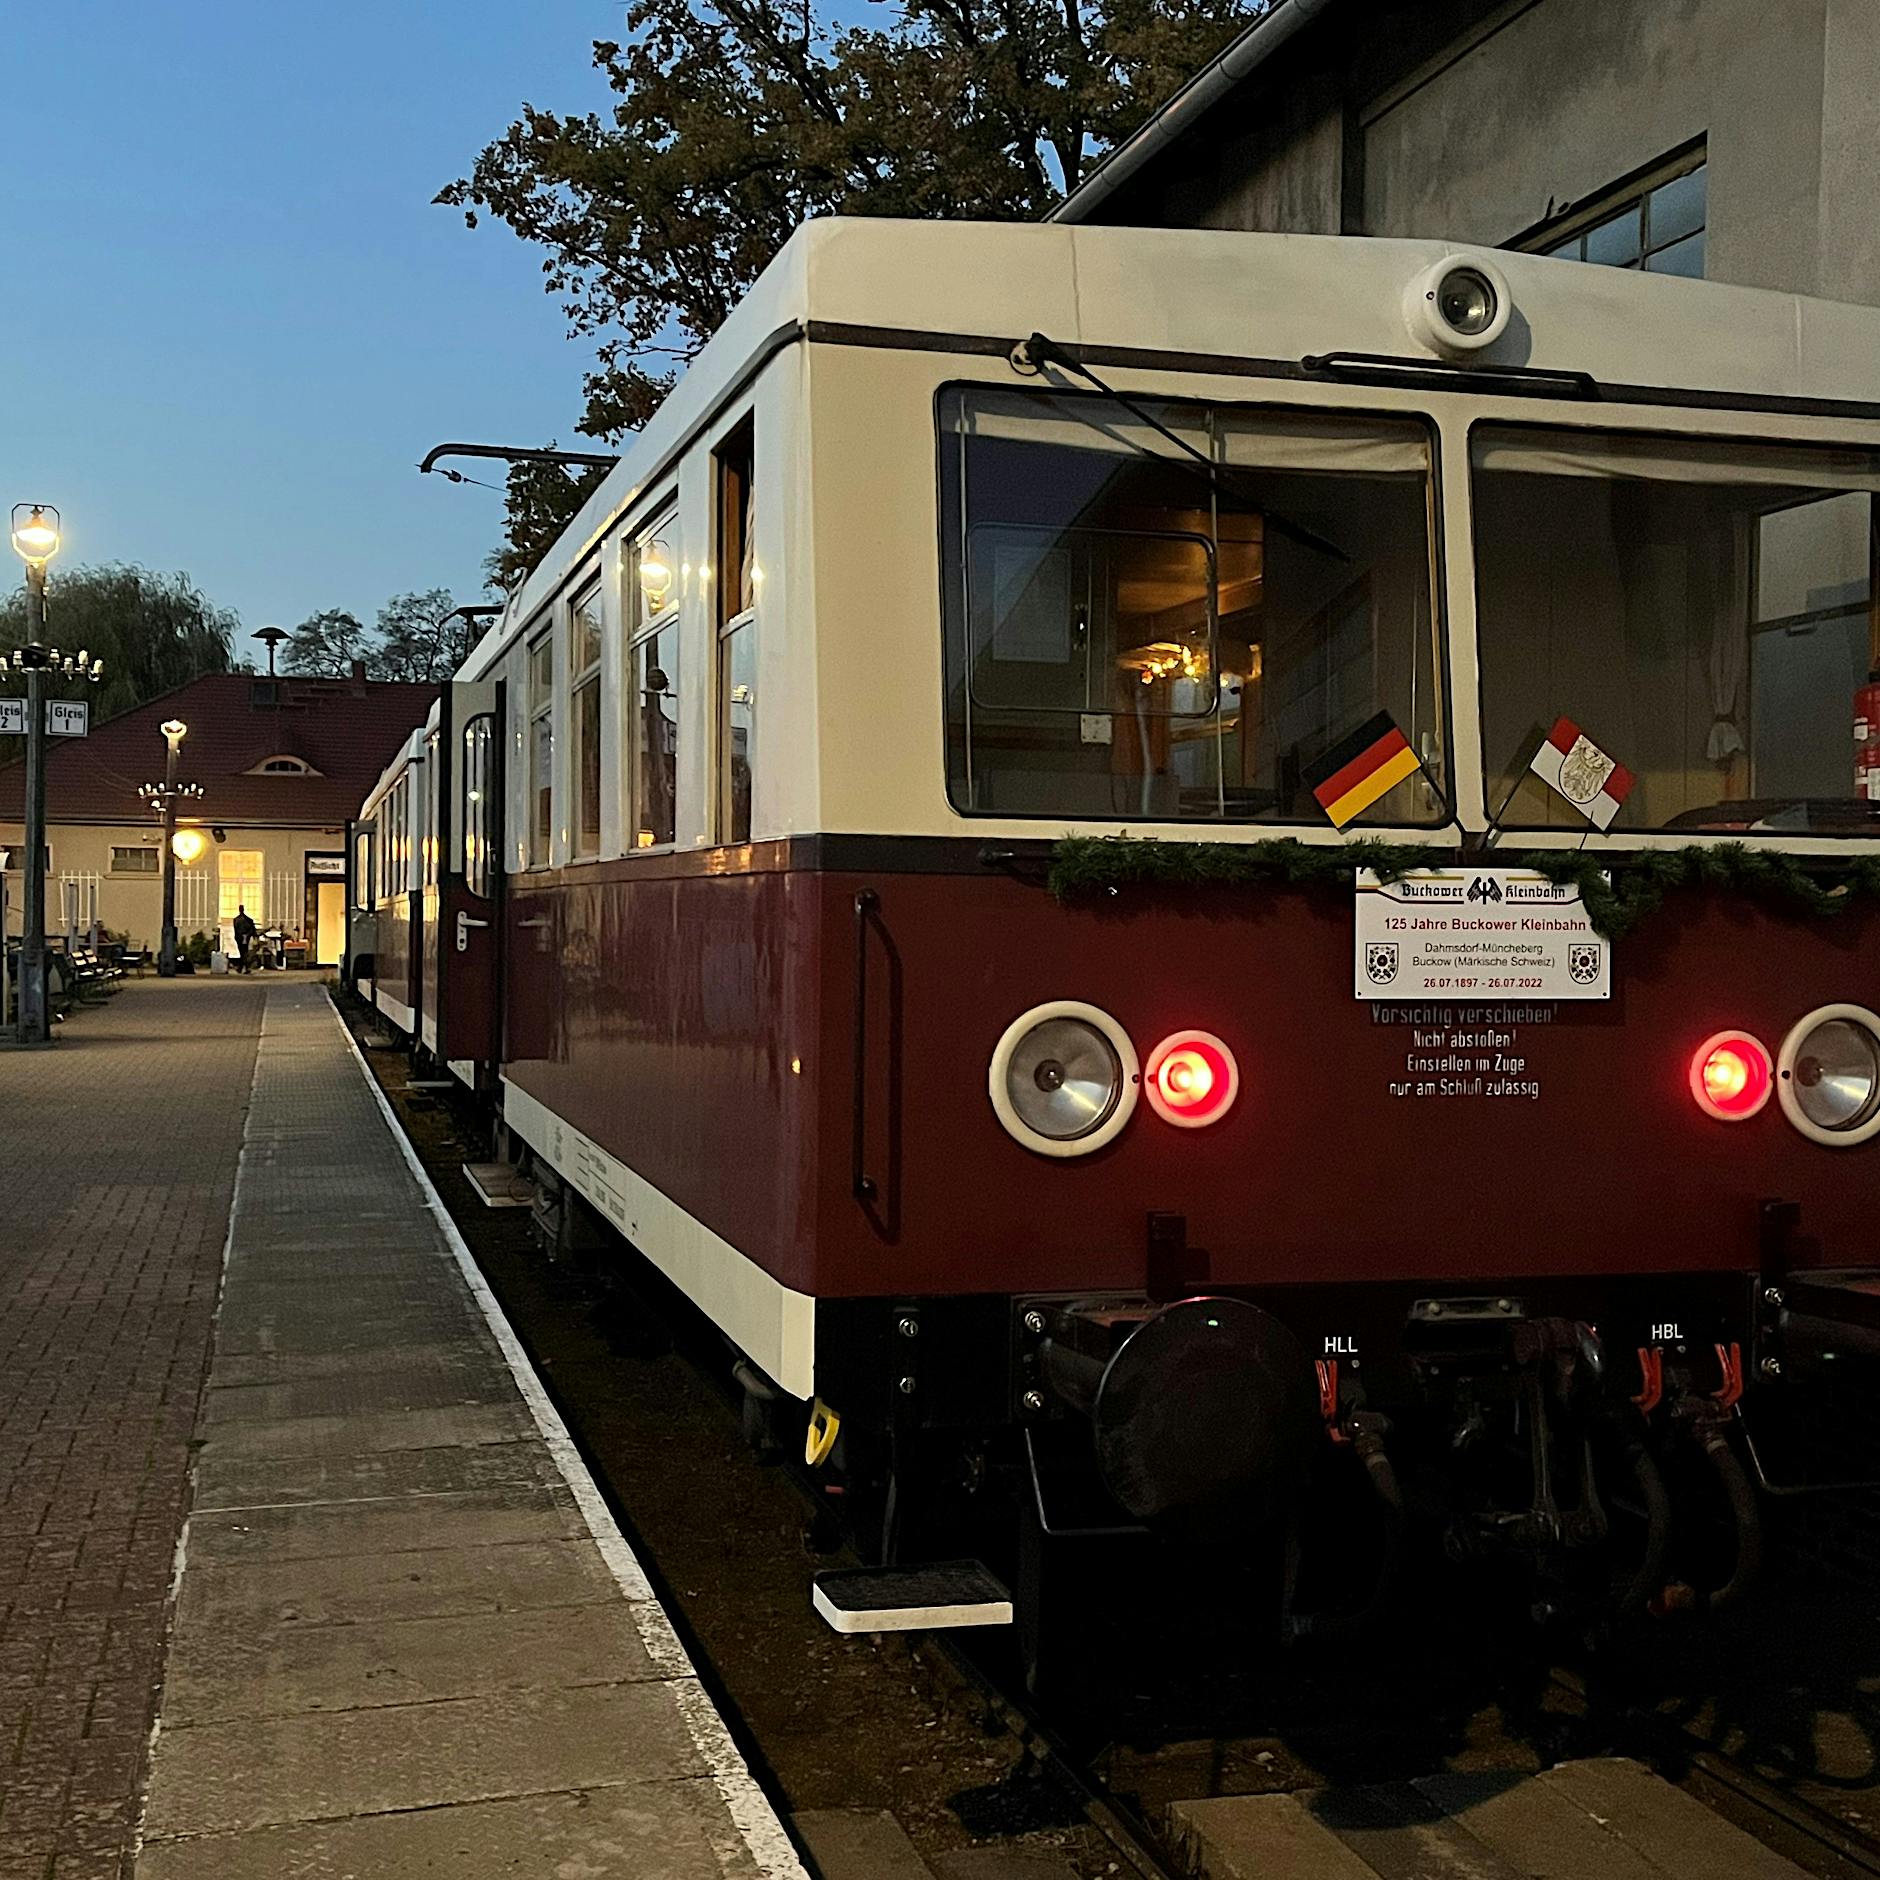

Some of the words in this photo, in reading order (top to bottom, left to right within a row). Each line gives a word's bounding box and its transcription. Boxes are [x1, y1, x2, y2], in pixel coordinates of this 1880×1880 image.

[0, 705, 21, 716] leis
[54, 706, 84, 719] Gleis
[1, 717, 9, 728] 2
[65, 719, 69, 730] 1
[1402, 884, 1463, 897] Buckower
[1505, 885, 1565, 899] Kleinbahn
[1385, 918, 1407, 930] 125
[1411, 918, 1447, 930] Jahre
[1452, 919, 1517, 930] Buckower
[1521, 919, 1586, 931] Kleinbahn
[1425, 943, 1543, 955] Dahmsdorf-Müncheberg
[1412, 956, 1452, 967] Buckow
[1511, 957, 1555, 968] Schweiz)
[1424, 978, 1478, 988] 26.07.1897
[1488, 978, 1543, 988] 26.07.2022
[1372, 1003, 1452, 1029] Vorsichtig
[1413, 1030, 1446, 1048] Nicht
[1407, 1054, 1471, 1072] Einstellen
[1475, 1058, 1490, 1072] im
[1495, 1054, 1525, 1076] Zuge
[1390, 1082, 1412, 1096] nur
[1416, 1082, 1436, 1096] am
[1651, 1324, 1683, 1340] HBL
[1324, 1337, 1358, 1354] HLL
